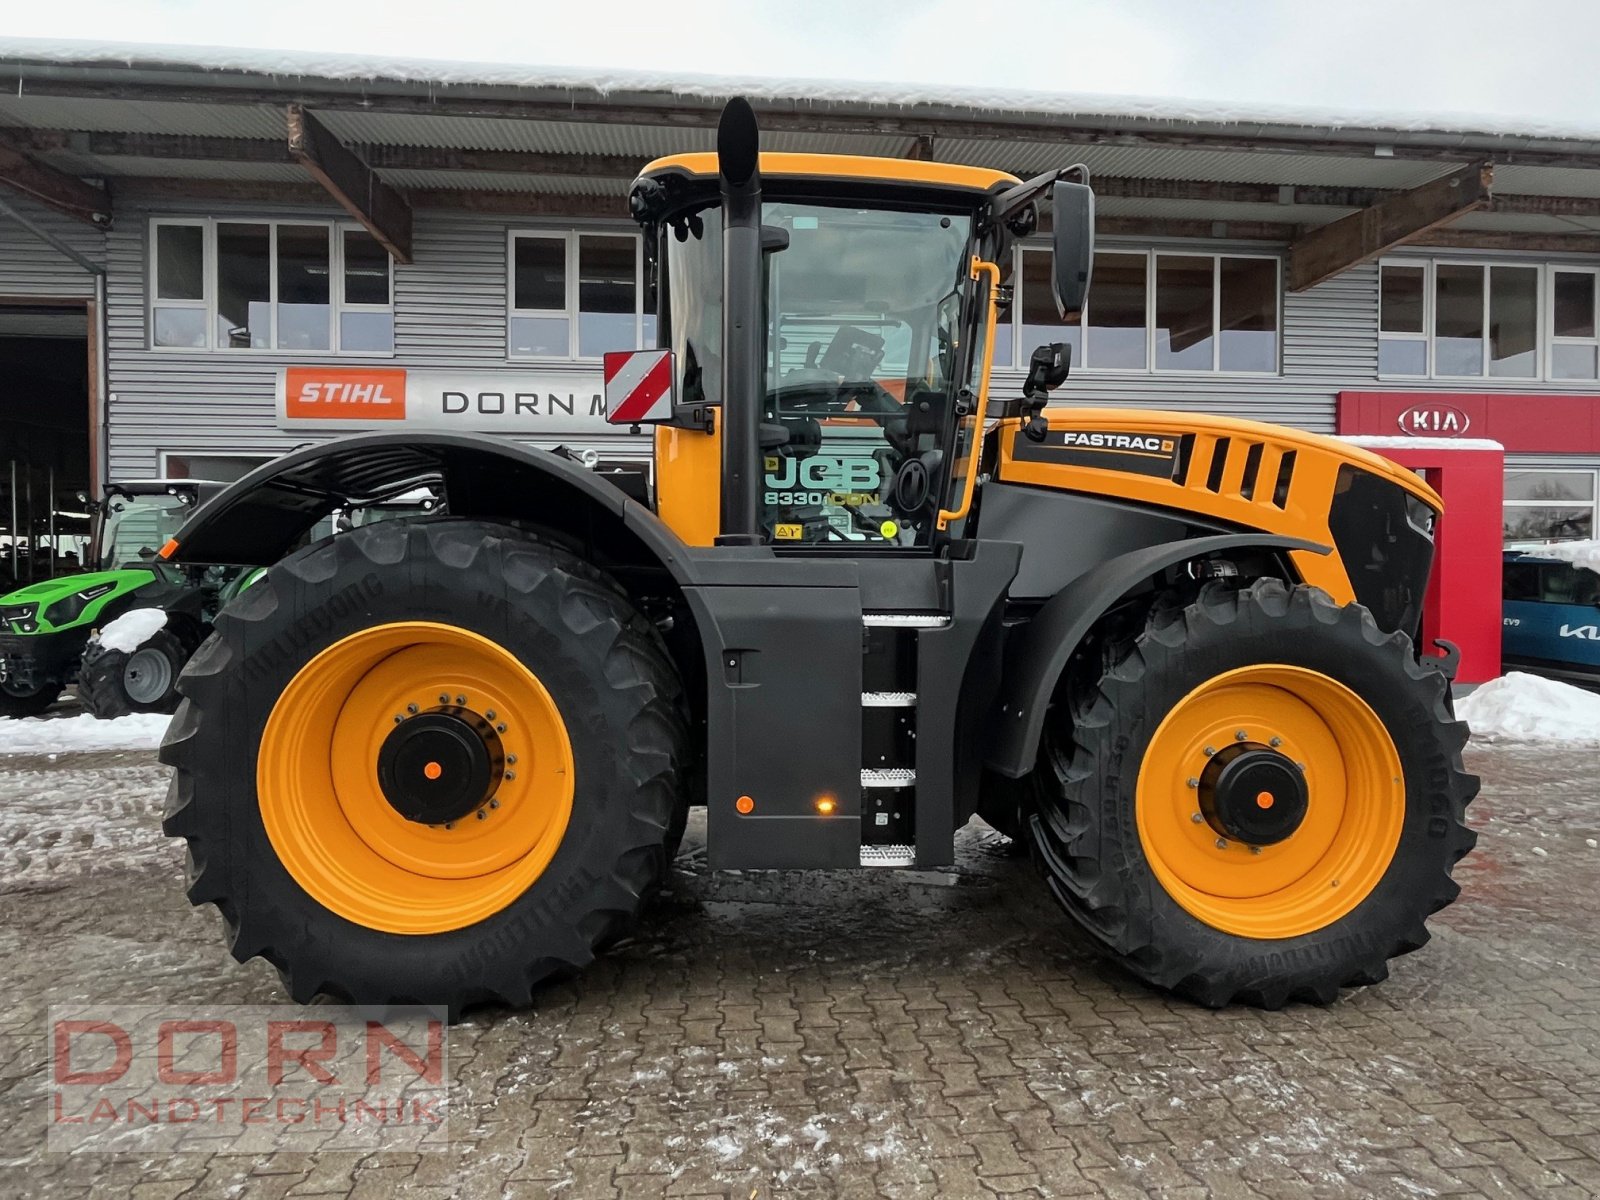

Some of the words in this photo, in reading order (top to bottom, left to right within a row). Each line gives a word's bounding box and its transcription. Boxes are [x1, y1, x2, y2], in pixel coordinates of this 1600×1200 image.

[299, 383, 392, 404] STIHL
[442, 392, 575, 416] DORN
[1413, 411, 1459, 431] KIA
[1064, 433, 1160, 451] FASTRAC
[765, 457, 881, 489] JCB
[764, 492, 822, 505] 8330
[1503, 617, 1520, 627] EV9
